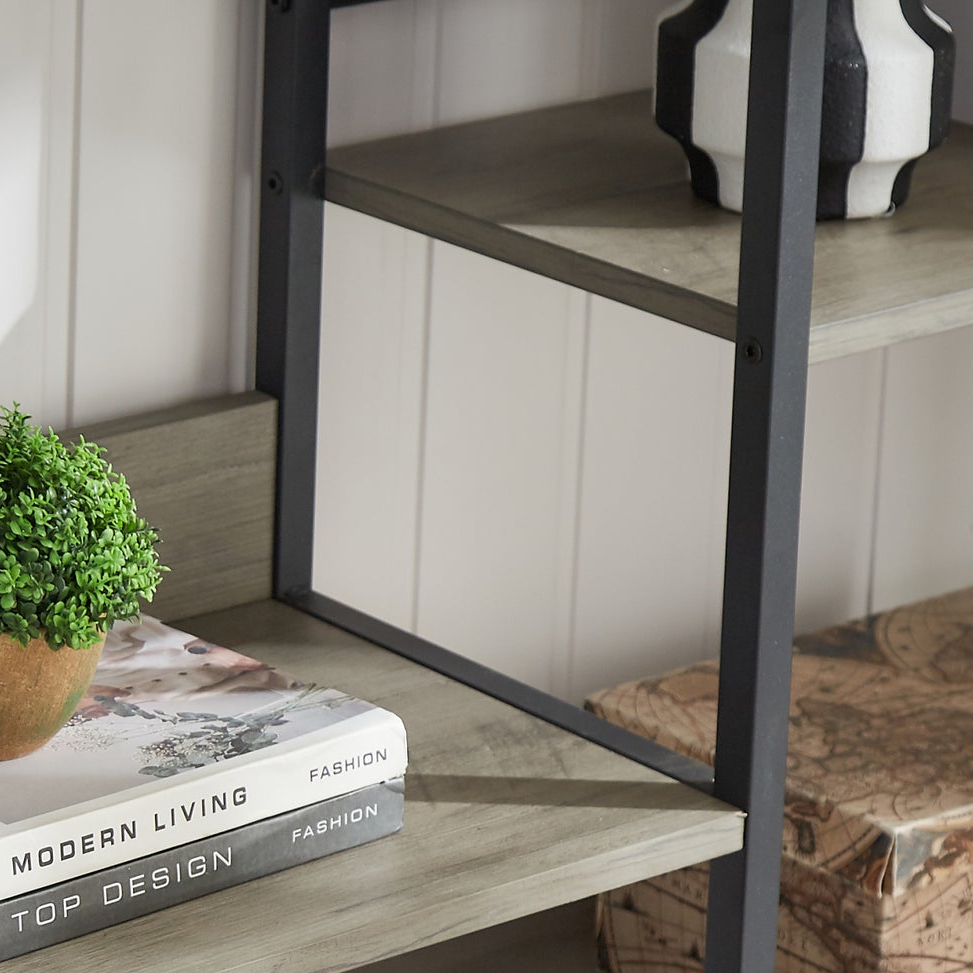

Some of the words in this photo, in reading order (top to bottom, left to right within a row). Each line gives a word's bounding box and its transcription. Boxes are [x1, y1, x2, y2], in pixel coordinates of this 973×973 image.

[11, 820, 137, 876] MODERN
[154, 786, 247, 832] LIVING
[309, 748, 387, 782] FASHION
[11, 895, 82, 933] TOP
[103, 846, 232, 906] DESIGN
[292, 803, 378, 843] FASHION
